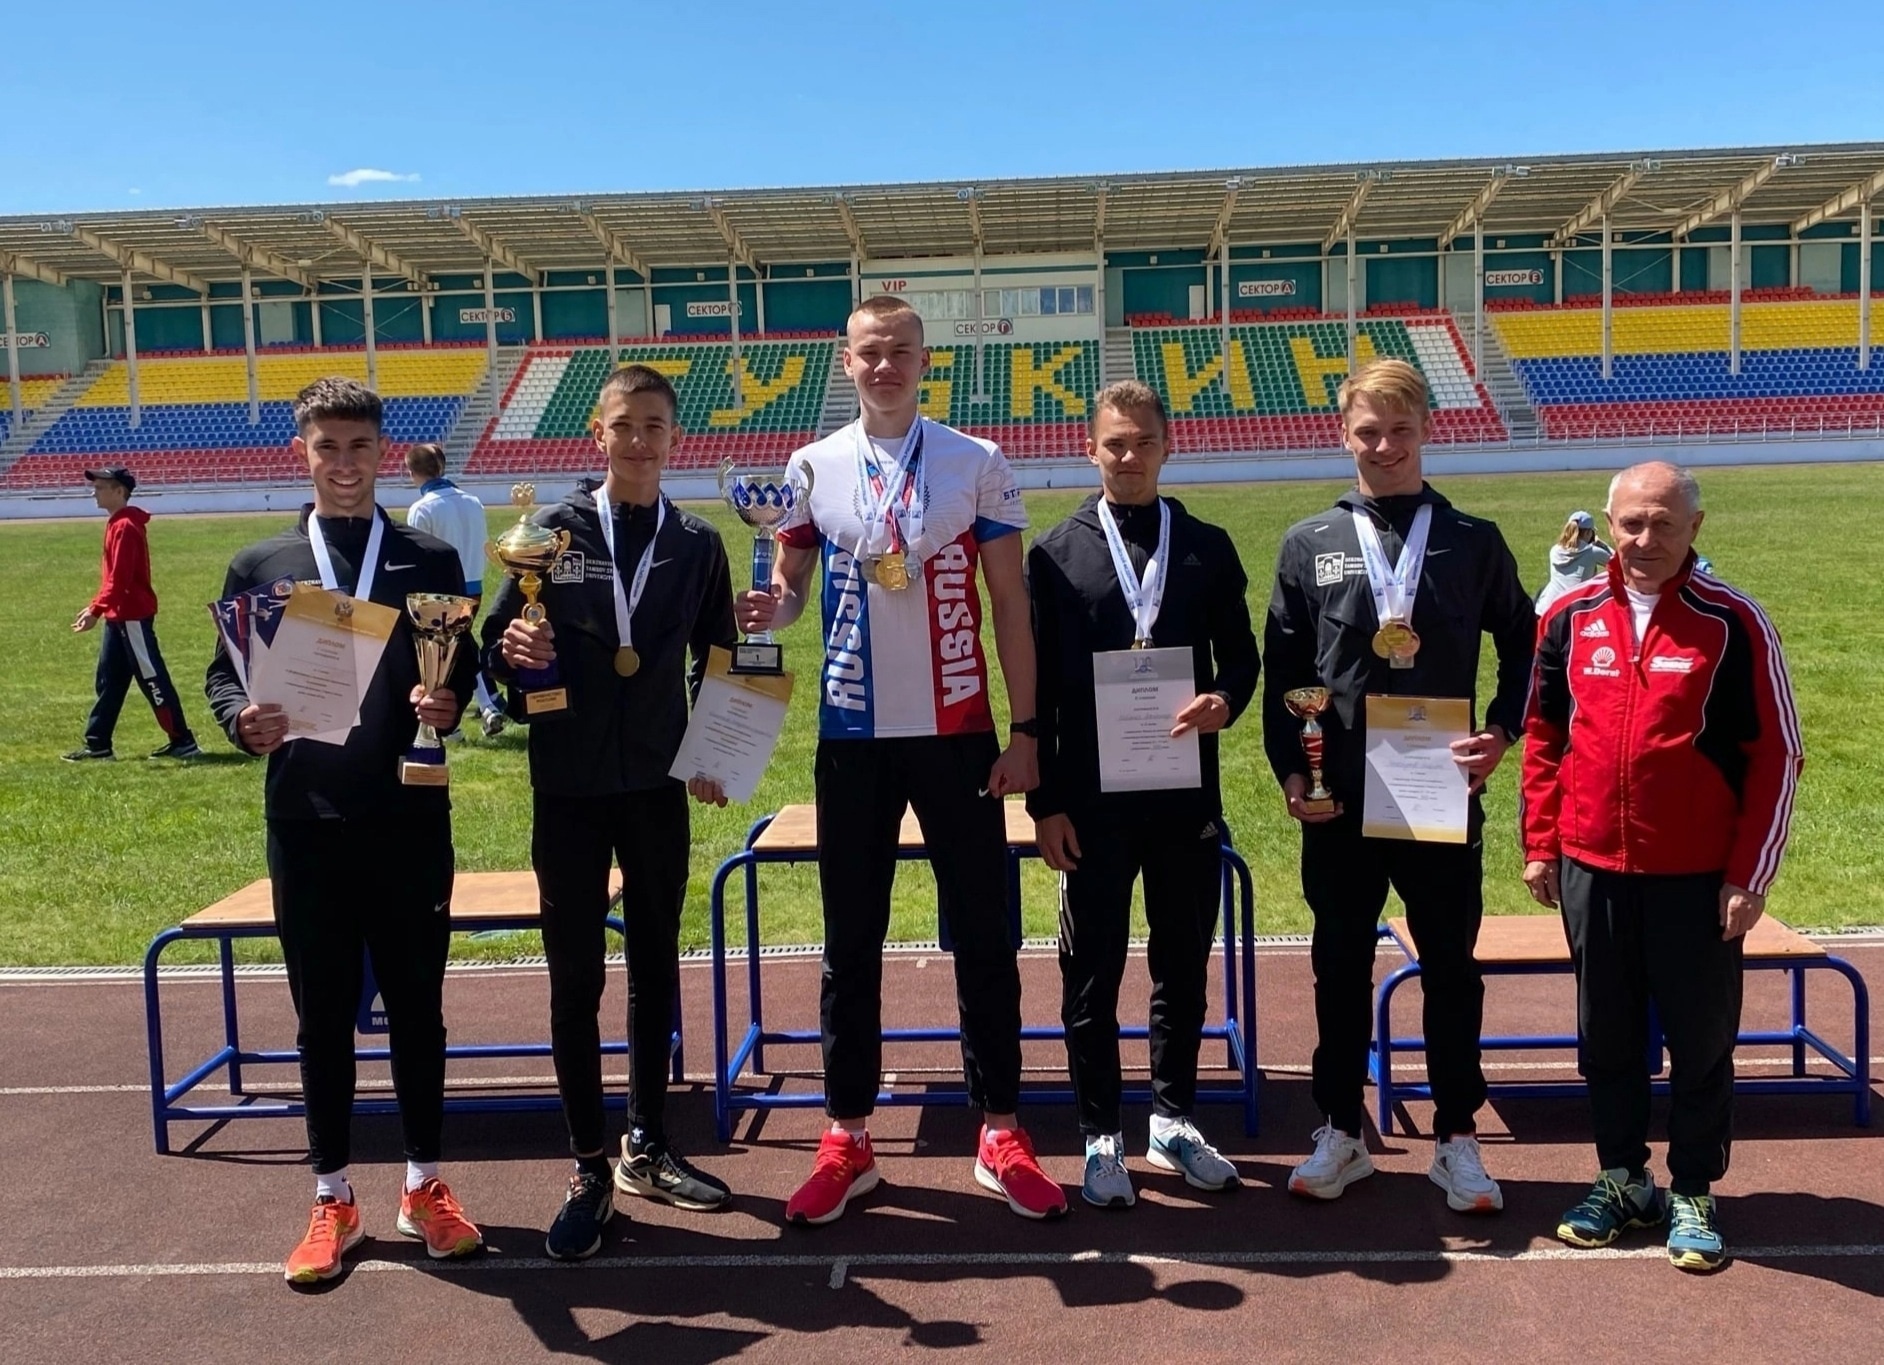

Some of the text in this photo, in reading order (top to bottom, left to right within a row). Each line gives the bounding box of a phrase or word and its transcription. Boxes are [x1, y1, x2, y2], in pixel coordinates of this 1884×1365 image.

[1486, 273, 1528, 285] СЕКТОР
[881, 280, 907, 291] VIP
[1240, 283, 1280, 295] СЕКТОР
[688, 304, 727, 315] СЕКТОР
[461, 310, 500, 322] СЕКТР
[955, 323, 996, 334] СЕКОР
[0, 336, 34, 347] ЕТОР
[826, 551, 866, 712] RUSSIA
[933, 544, 981, 708] RUSSIA
